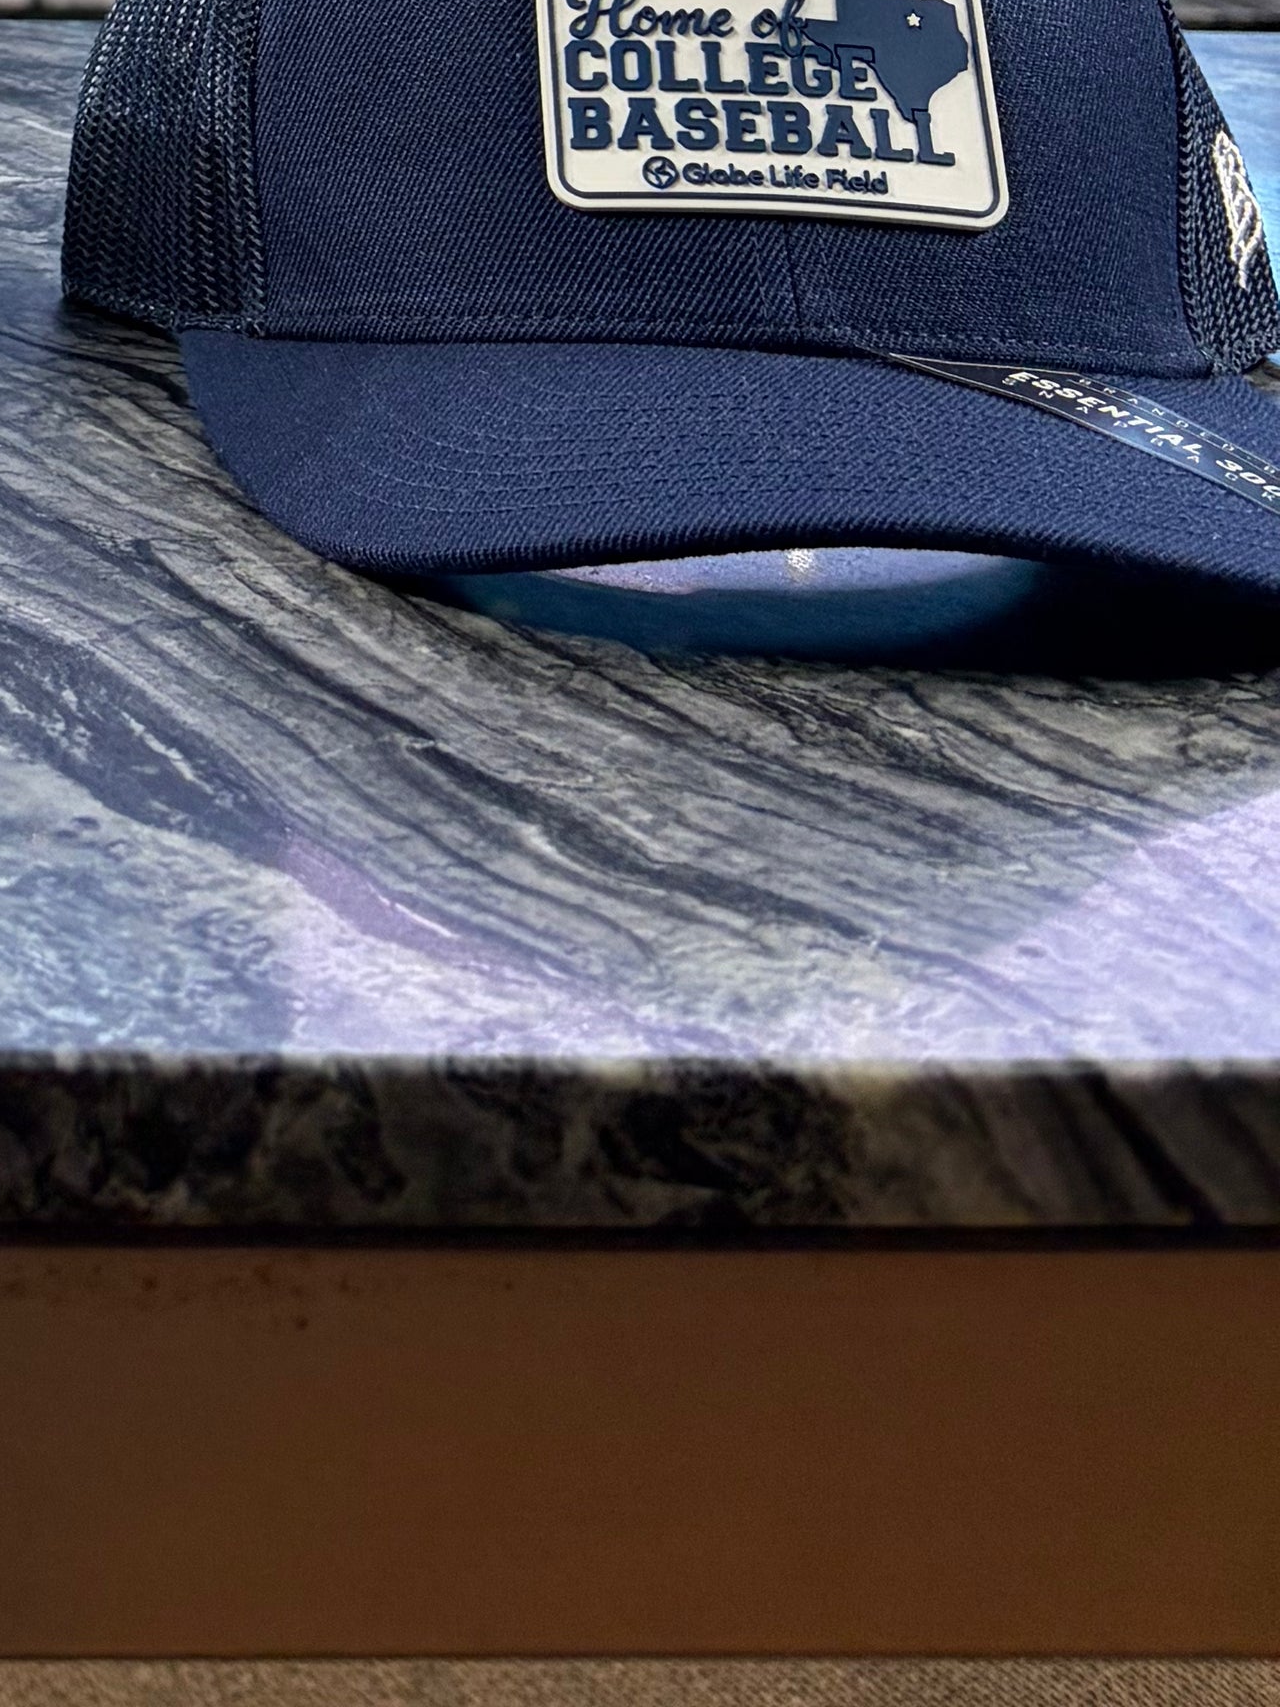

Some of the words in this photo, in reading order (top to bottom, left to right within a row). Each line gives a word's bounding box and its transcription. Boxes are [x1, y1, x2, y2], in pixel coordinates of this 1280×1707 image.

[564, 38, 880, 102] COLLEGE
[566, 96, 956, 167] BASEBALL
[682, 162, 765, 187] Globe
[768, 164, 821, 190] Life
[825, 167, 889, 195] Field
[1007, 370, 1203, 457] ESSENTIAL
